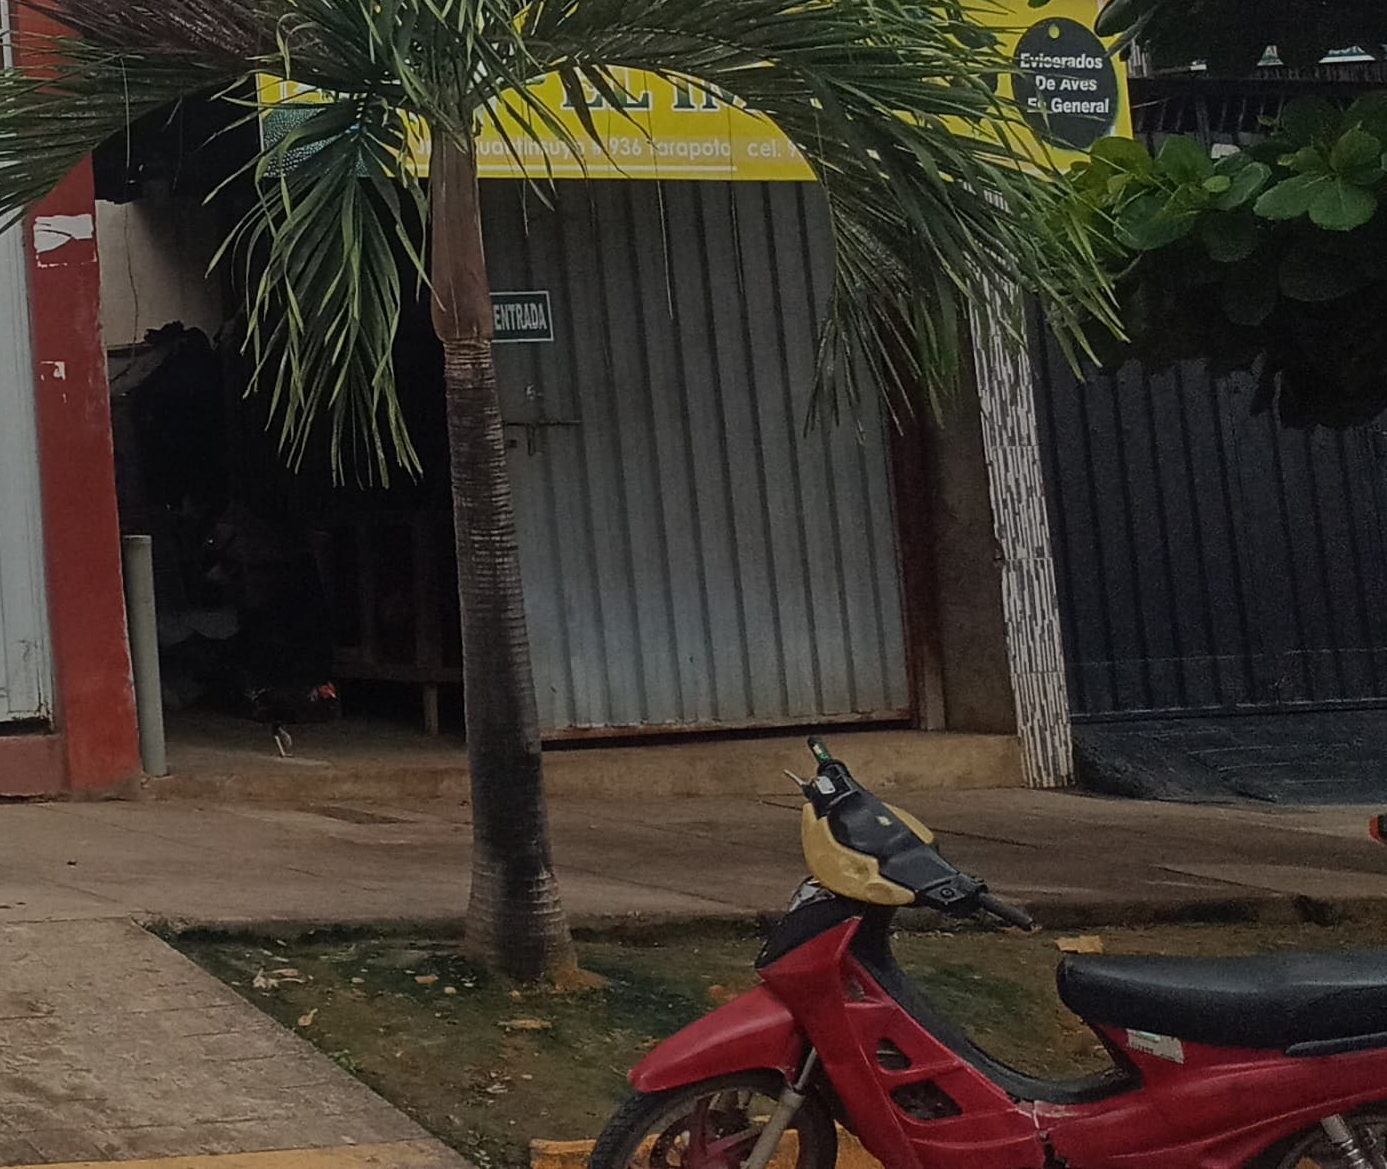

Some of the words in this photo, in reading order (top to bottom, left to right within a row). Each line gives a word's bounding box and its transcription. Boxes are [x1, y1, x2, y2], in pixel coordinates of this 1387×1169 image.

[1035, 75, 1056, 90] De
[1059, 79, 1098, 91] Aves
[1050, 97, 1109, 113] General
[611, 139, 642, 157] 936
[493, 303, 548, 331] ENTRADA
